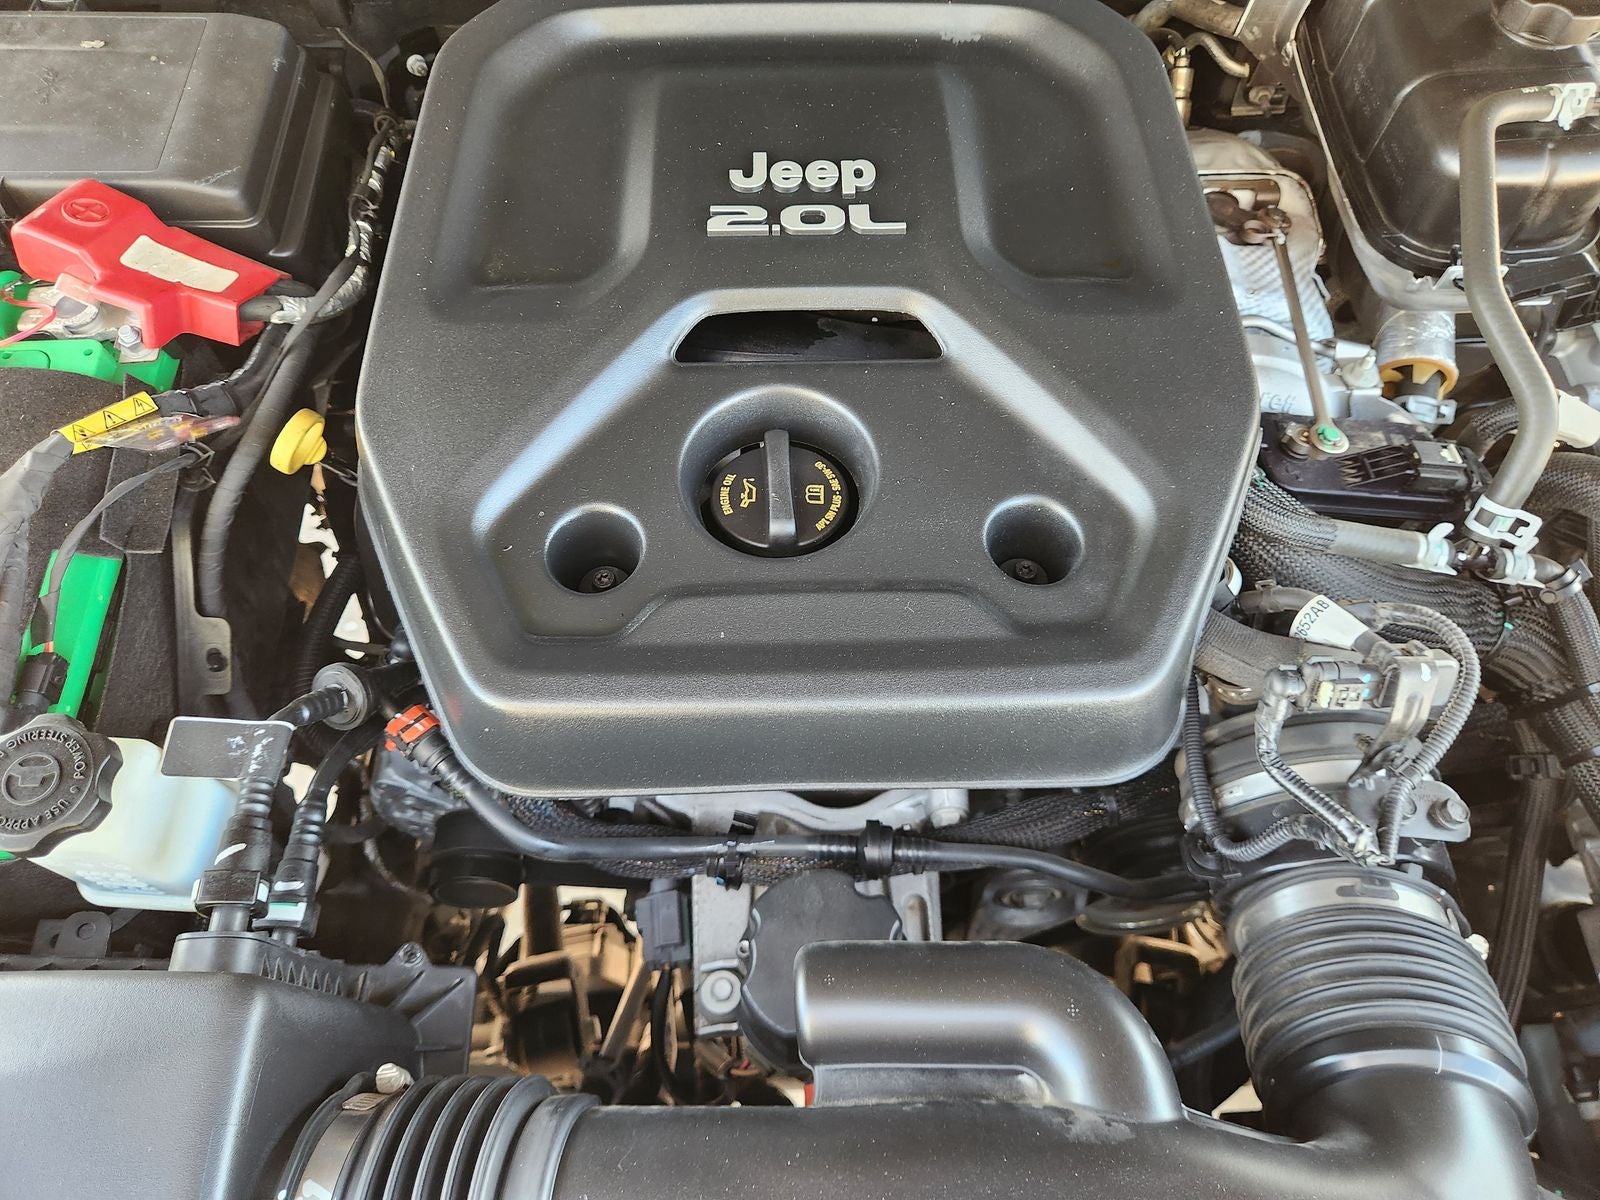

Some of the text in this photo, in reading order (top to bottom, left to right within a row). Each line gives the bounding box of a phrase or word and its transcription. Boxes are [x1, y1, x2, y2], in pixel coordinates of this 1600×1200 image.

[728, 151, 877, 199] Jeep
[706, 203, 907, 237] 2.0L
[720, 474, 737, 516] ENGINE OIL
[828, 478, 842, 491] SAE
[829, 494, 843, 512] PLUS
[815, 517, 831, 531] API
[6, 729, 86, 780] POWER STEERING
[44, 798, 70, 820] USE
